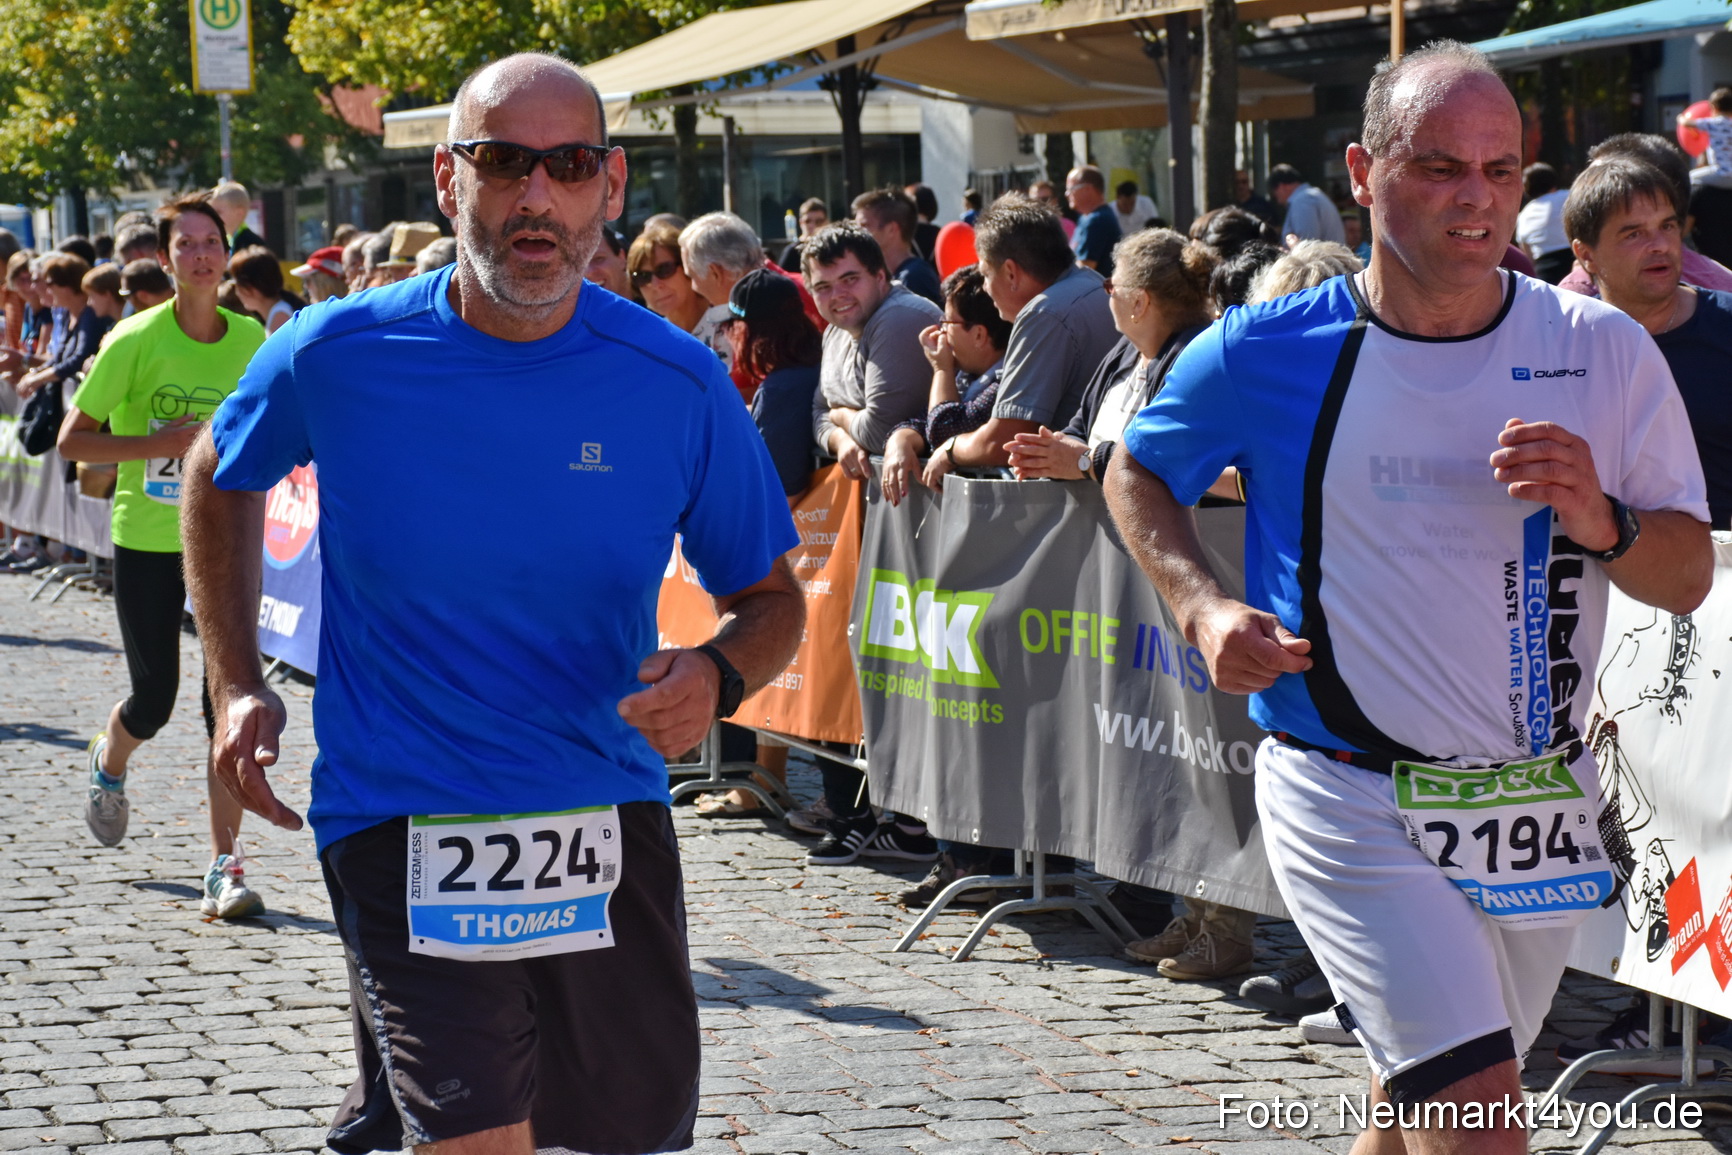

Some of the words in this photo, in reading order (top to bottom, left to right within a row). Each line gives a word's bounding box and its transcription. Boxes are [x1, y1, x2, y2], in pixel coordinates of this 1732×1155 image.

[568, 462, 614, 473] salomon
[1369, 455, 1501, 486] HUBE
[1440, 545, 1468, 560] the
[1504, 560, 1519, 622] WASTE
[1509, 627, 1523, 688] WATER
[785, 673, 803, 691] 897
[857, 662, 924, 699] inspired
[438, 827, 600, 893] 2224
[603, 828, 612, 840] D
[1424, 812, 1581, 874] 2194
[1578, 814, 1587, 825] D
[452, 905, 578, 938] THOMAS
